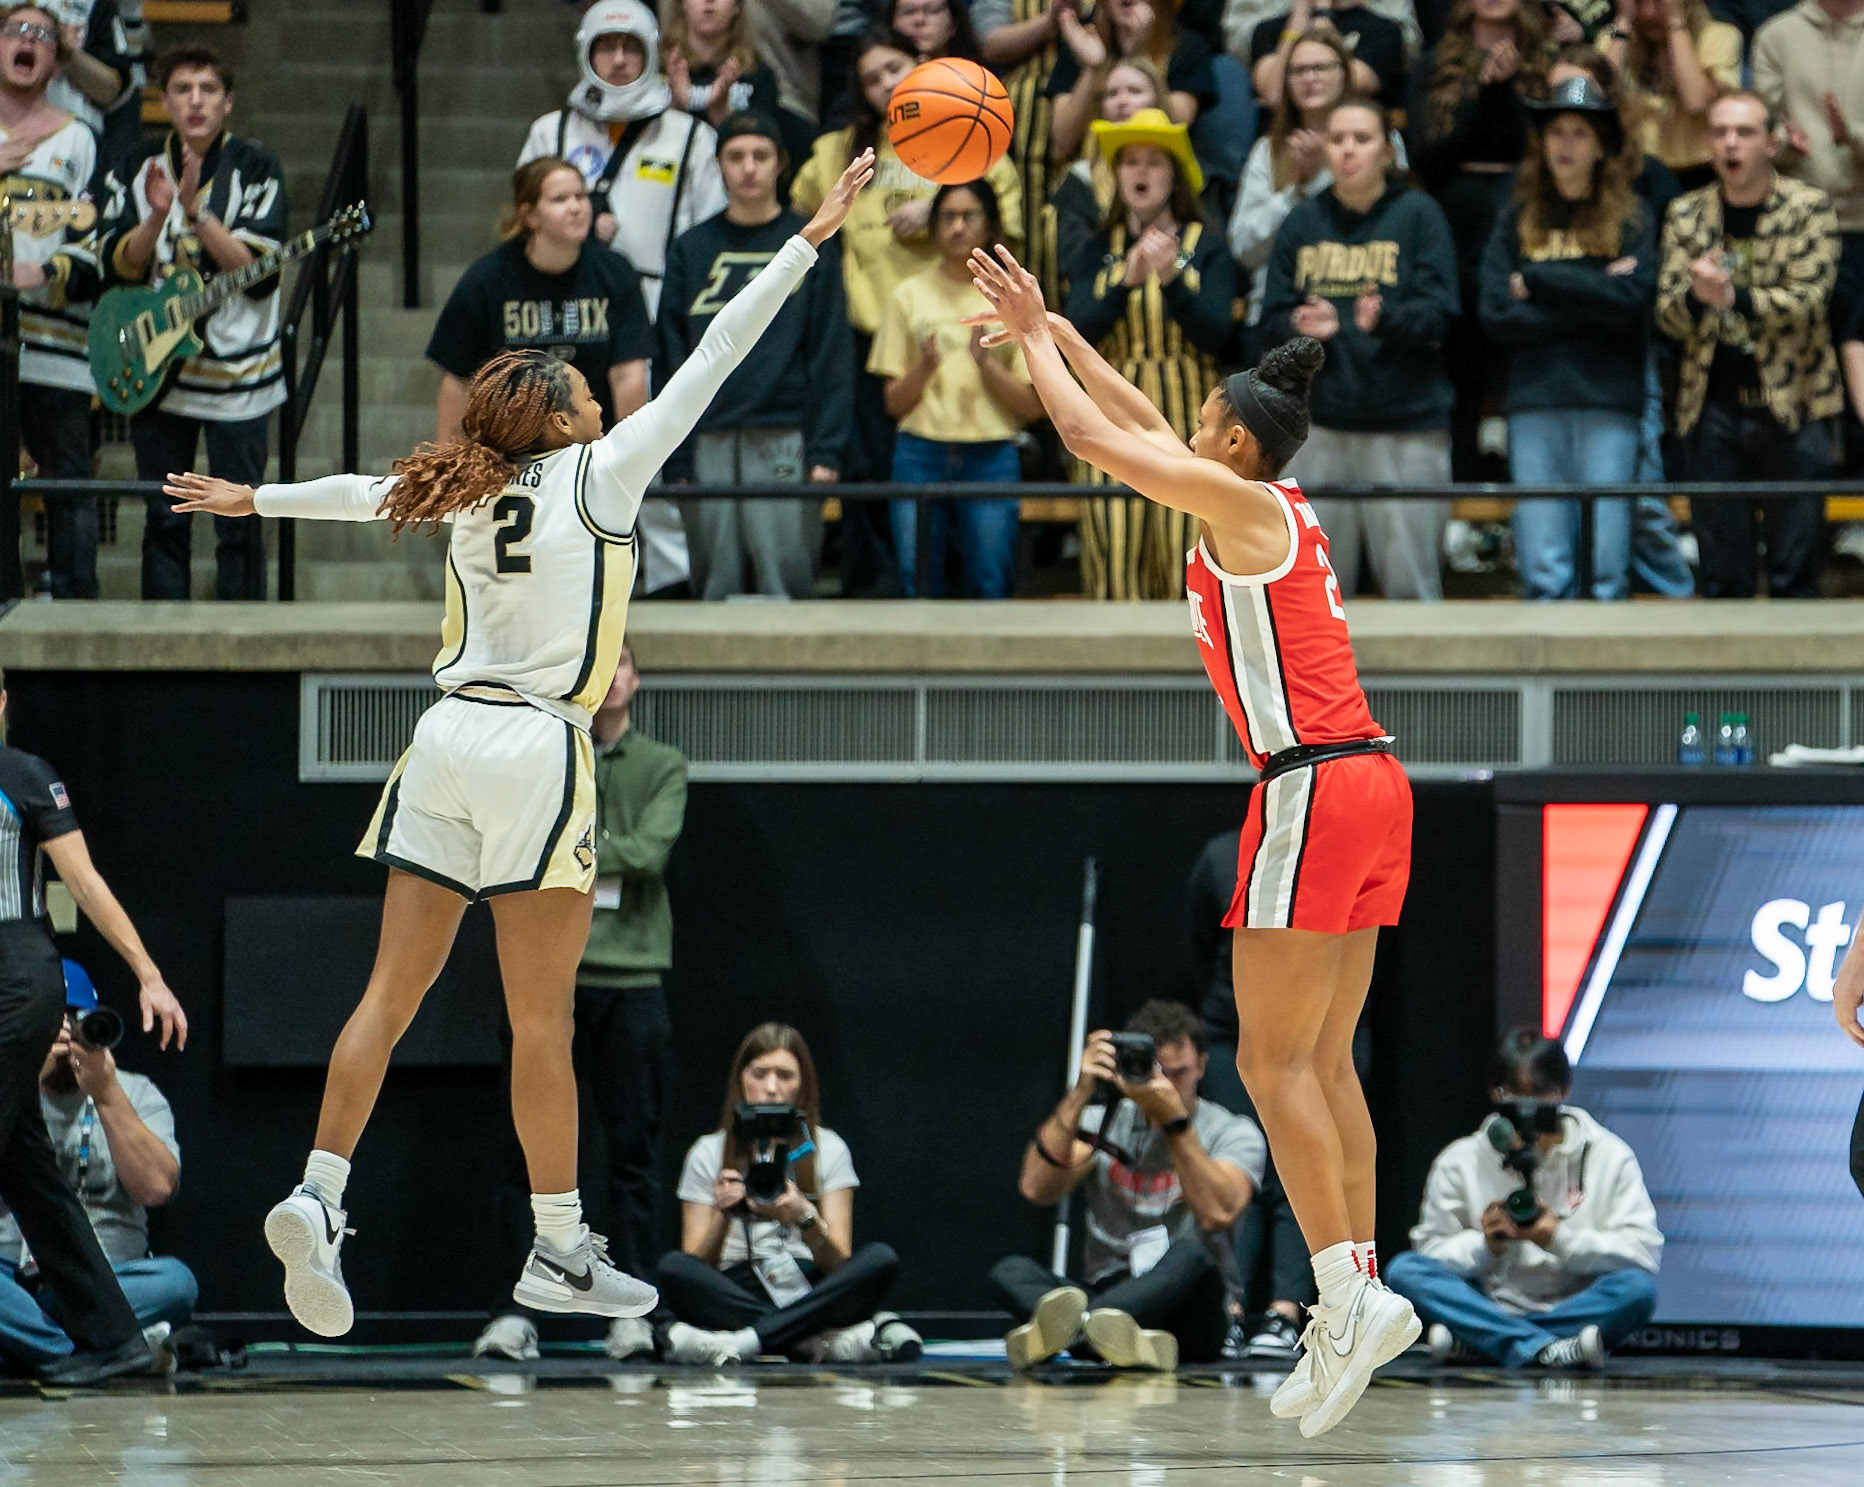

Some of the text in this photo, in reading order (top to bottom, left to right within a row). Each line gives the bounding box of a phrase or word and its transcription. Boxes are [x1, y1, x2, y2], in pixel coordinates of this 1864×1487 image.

[1295, 240, 1400, 290] PURDUE
[503, 299, 540, 338] 50
[579, 298, 609, 337] IX
[493, 495, 536, 573] 2
